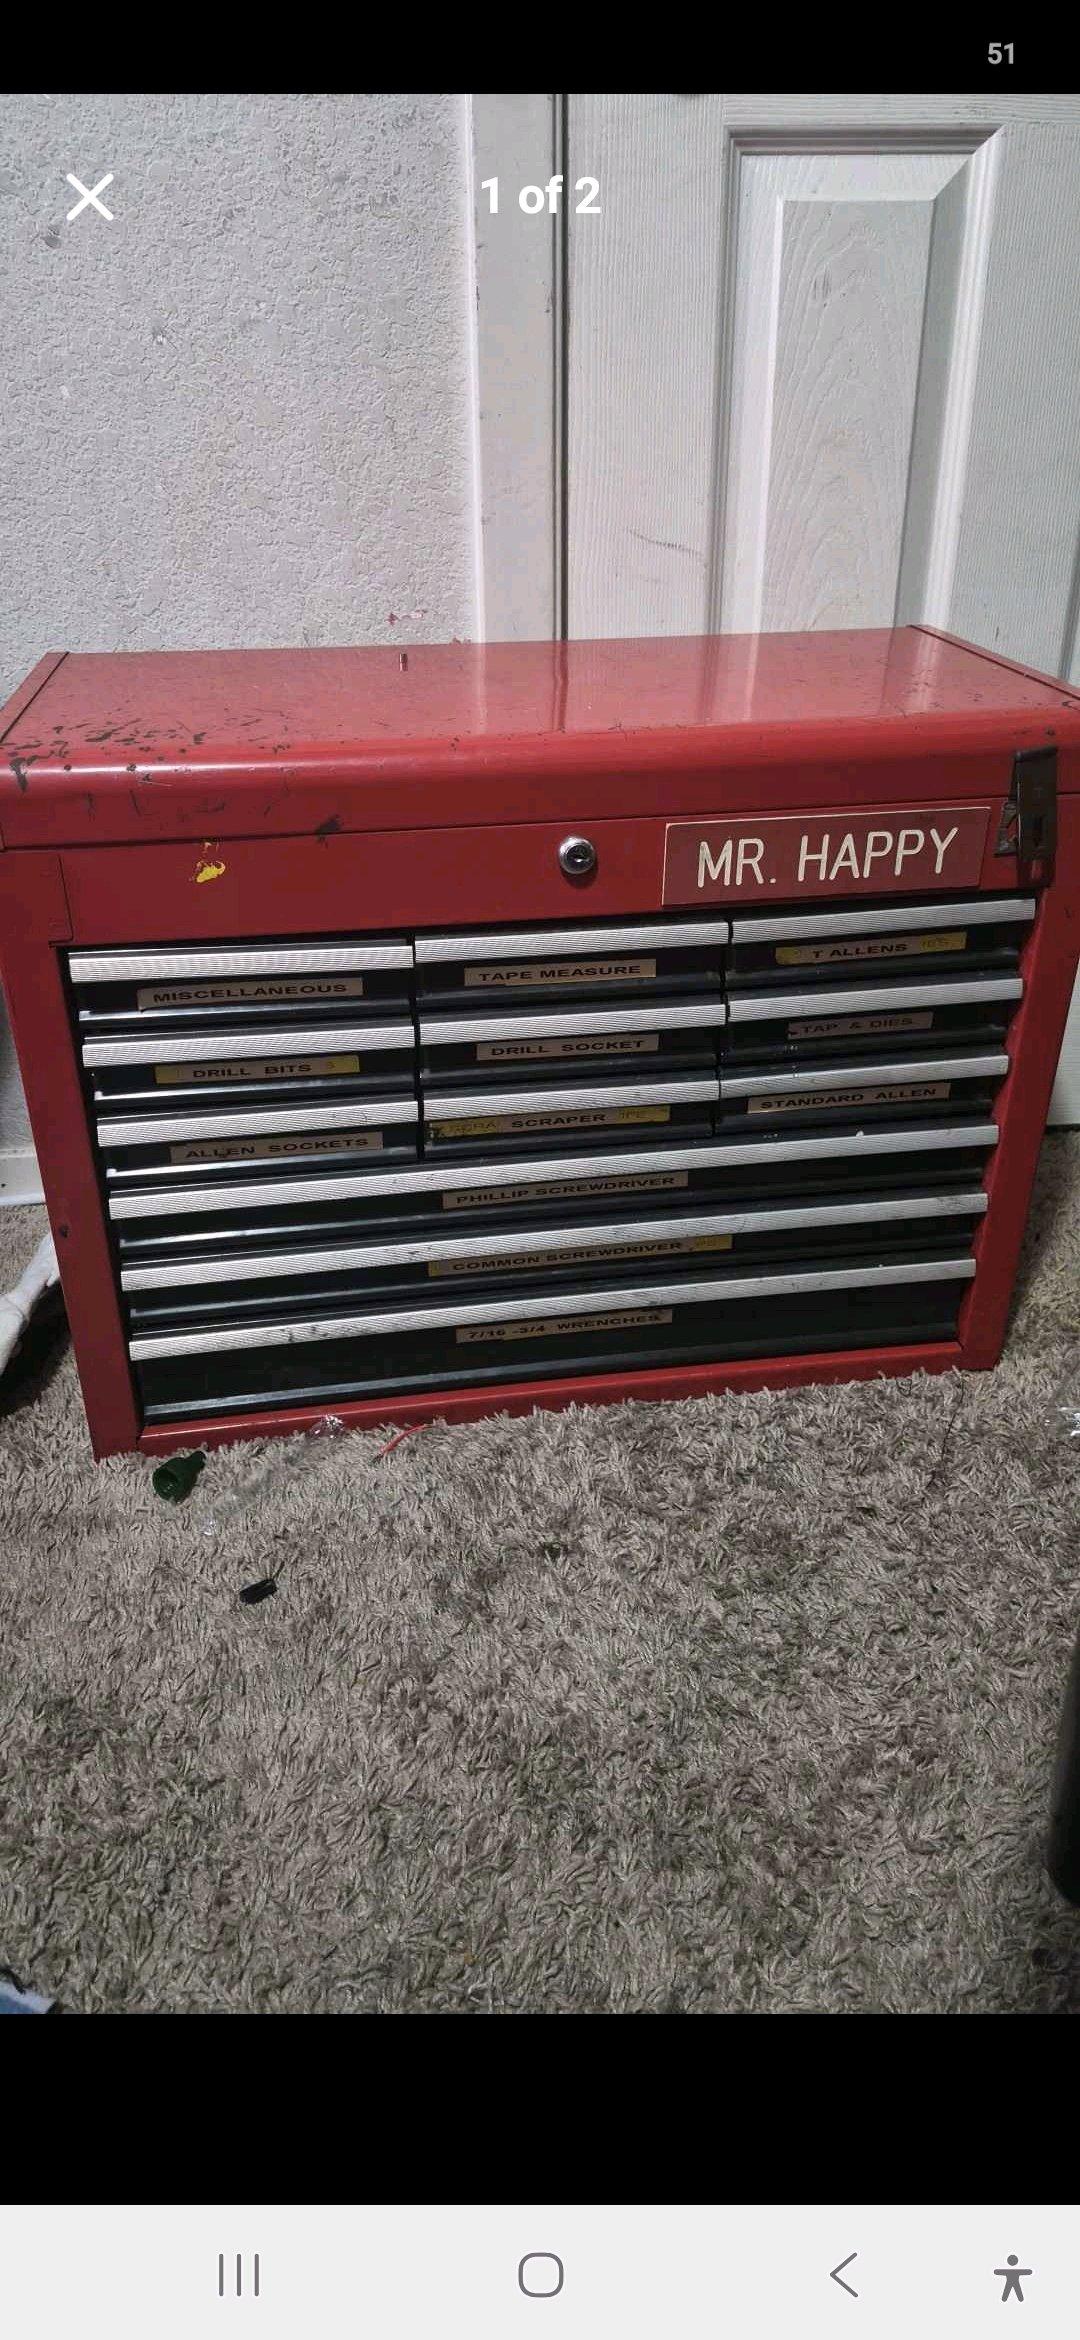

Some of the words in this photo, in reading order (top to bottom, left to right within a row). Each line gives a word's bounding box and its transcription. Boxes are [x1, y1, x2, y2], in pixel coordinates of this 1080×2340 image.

[697, 837, 777, 888] MR.
[797, 826, 959, 883] HAPPY
[812, 949, 824, 959] T
[829, 943, 908, 957] ALLENS
[479, 971, 533, 982] TAPE
[540, 965, 641, 979] MEASURE
[153, 983, 347, 1004] MISCELLANEOUS
[801, 1023, 839, 1034] TAP
[848, 1021, 861, 1030] &
[869, 1017, 914, 1029] DIES
[491, 1045, 549, 1056] DRILL
[561, 1040, 645, 1053] SOCKET
[192, 1066, 251, 1078] DRILL
[264, 1063, 313, 1075] BITS
[760, 1093, 864, 1109] STANDARD
[874, 1088, 937, 1100] ALLEN
[511, 1113, 607, 1128] SCRAPER
[185, 1146, 255, 1159] ALLEN
[267, 1138, 369, 1153] SOCKETS
[456, 1190, 529, 1203] PHILLIP
[535, 1177, 675, 1196] SCREWDRIVER
[452, 1256, 540, 1271] COMMON
[546, 1241, 682, 1261] SCREWDRIVER
[556, 1313, 663, 1331] WRENCHES
